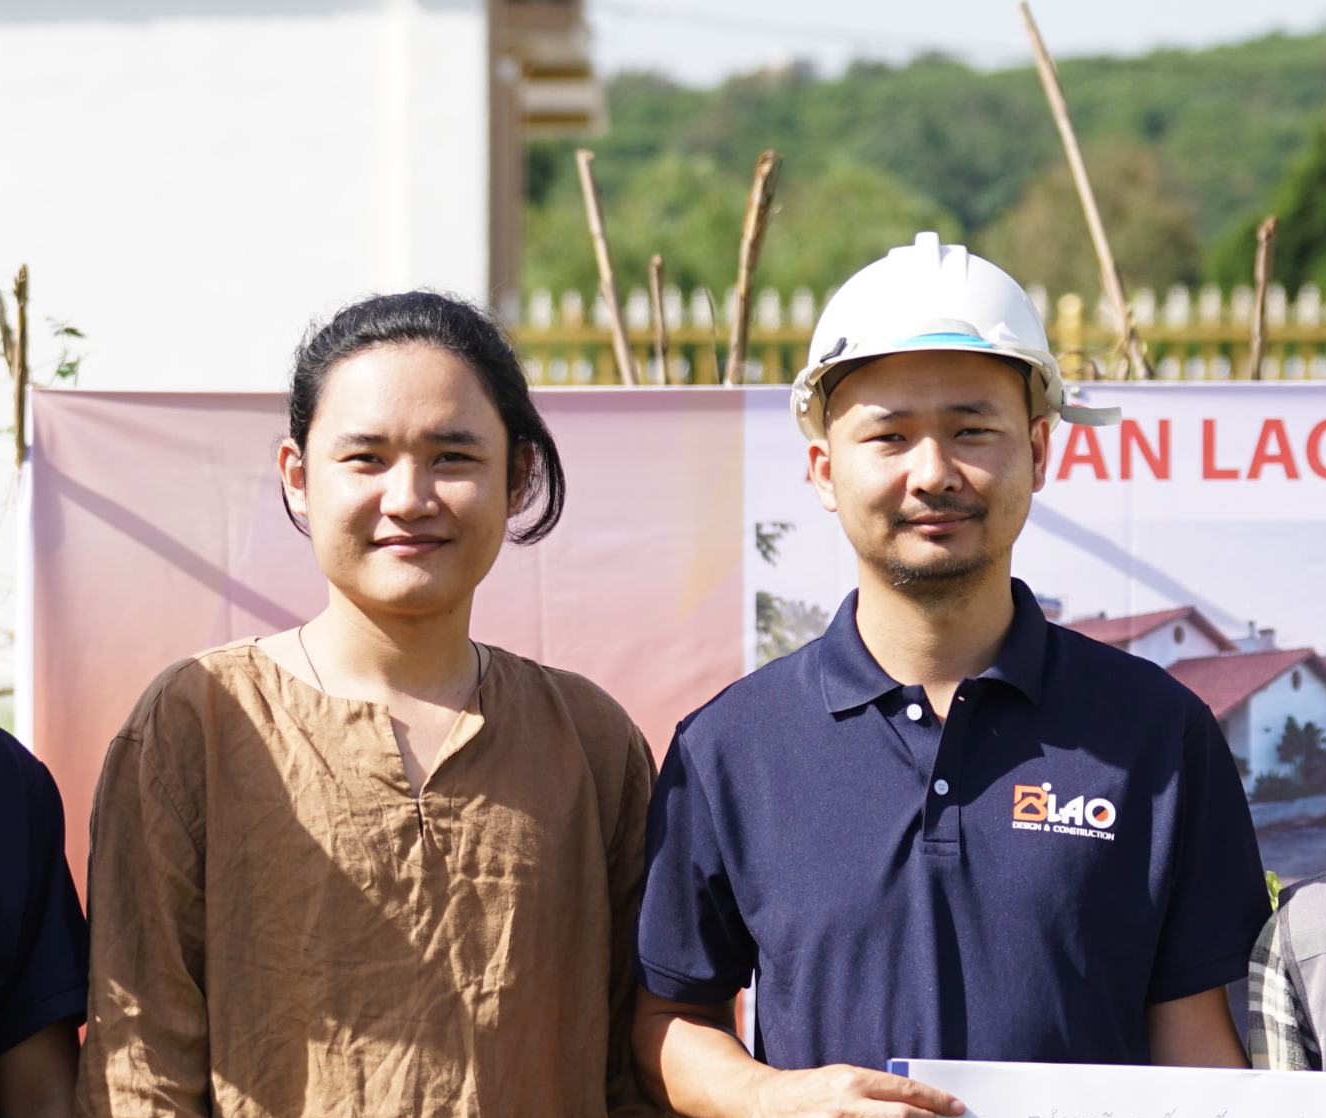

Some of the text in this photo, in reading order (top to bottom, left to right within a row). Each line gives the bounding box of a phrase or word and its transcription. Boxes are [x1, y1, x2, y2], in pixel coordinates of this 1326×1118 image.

[1012, 821, 1115, 841] DESIGN & CONSTRUCTION
